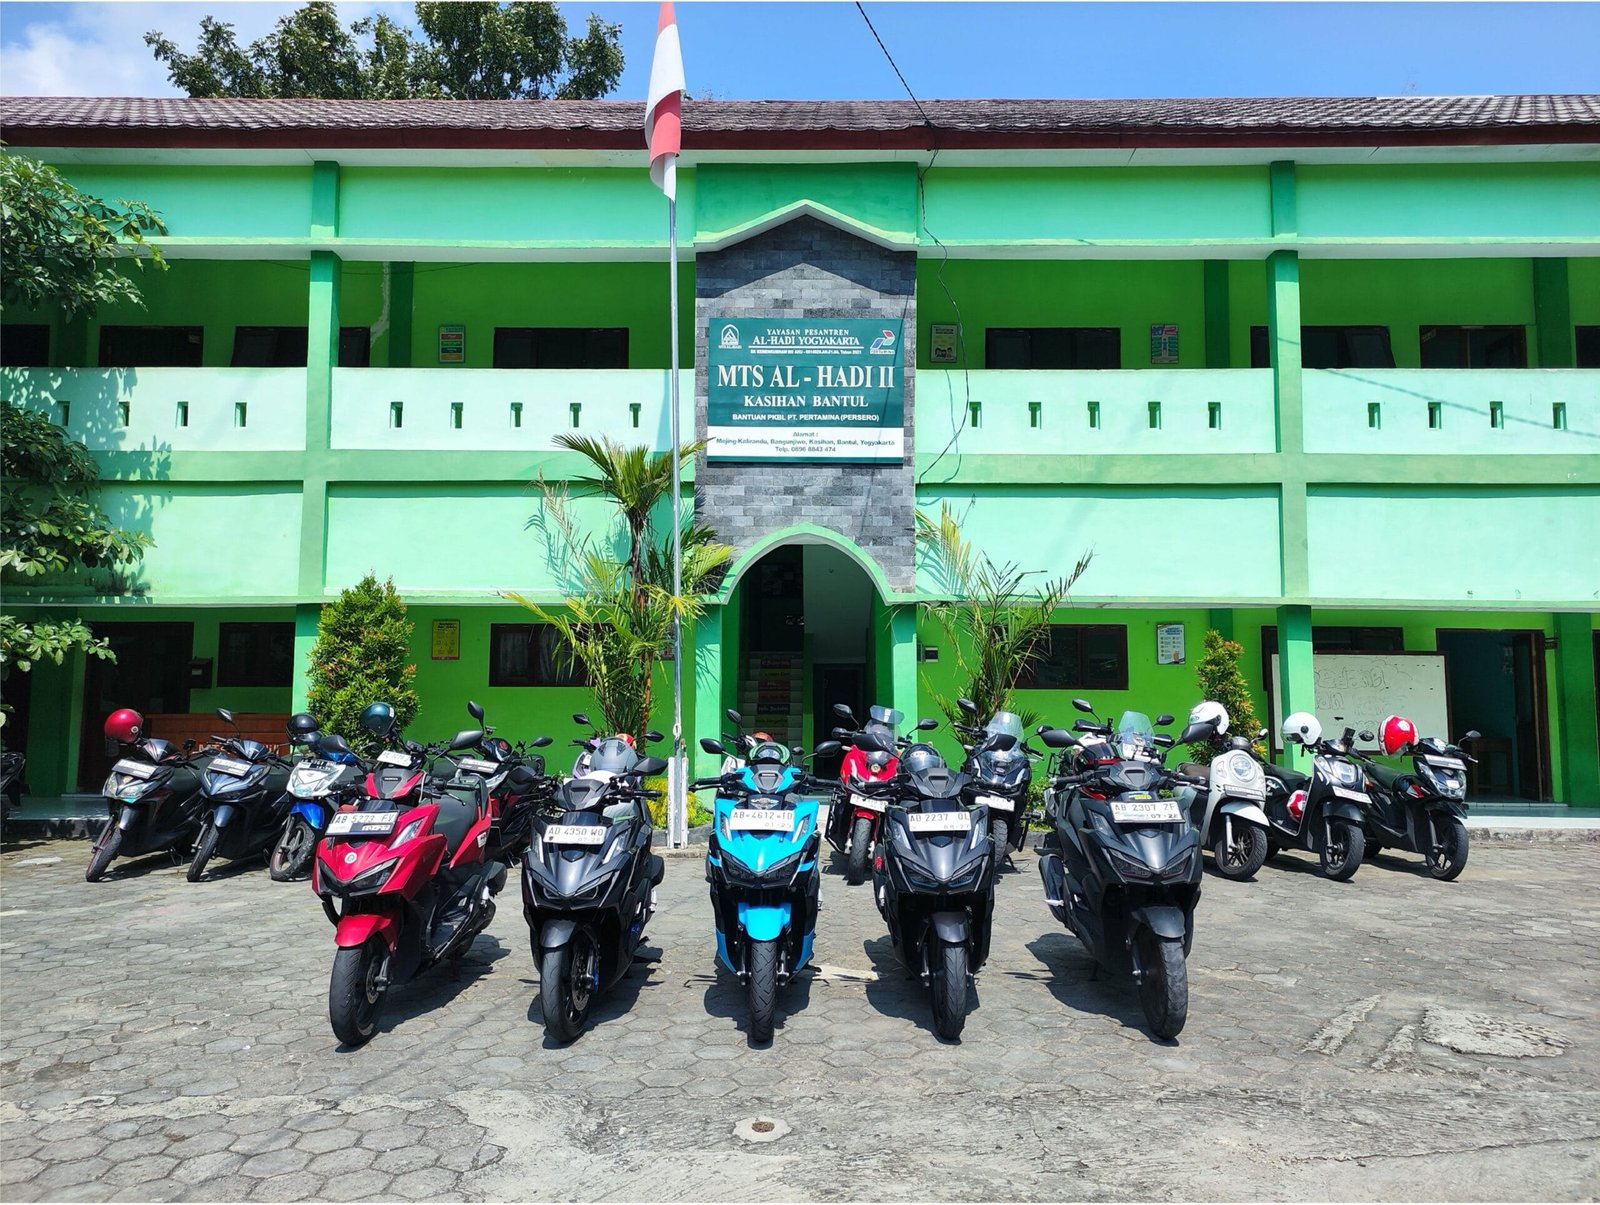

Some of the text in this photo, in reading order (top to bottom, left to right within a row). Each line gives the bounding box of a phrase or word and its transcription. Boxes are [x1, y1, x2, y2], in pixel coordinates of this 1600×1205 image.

[767, 328, 849, 336] YAYASAN PESANTREN
[752, 336, 860, 345] AL-HADI YOGYAKARTA
[717, 364, 765, 388] MTS
[769, 365, 800, 388] AL
[816, 365, 873, 388] HADI
[878, 365, 895, 388] II
[744, 395, 868, 407] KASIHAN BANTUL
[732, 413, 766, 421] BANTUAN
[767, 413, 787, 421] PKBL
[840, 414, 880, 422] (PERSERO)
[1114, 803, 1127, 812] AB
[1131, 803, 1157, 812] 2307
[334, 815, 348, 824] AB
[381, 813, 395, 822] FV
[925, 813, 949, 822] 2237
[548, 826, 561, 835] AD
[564, 827, 588, 836] 4350
